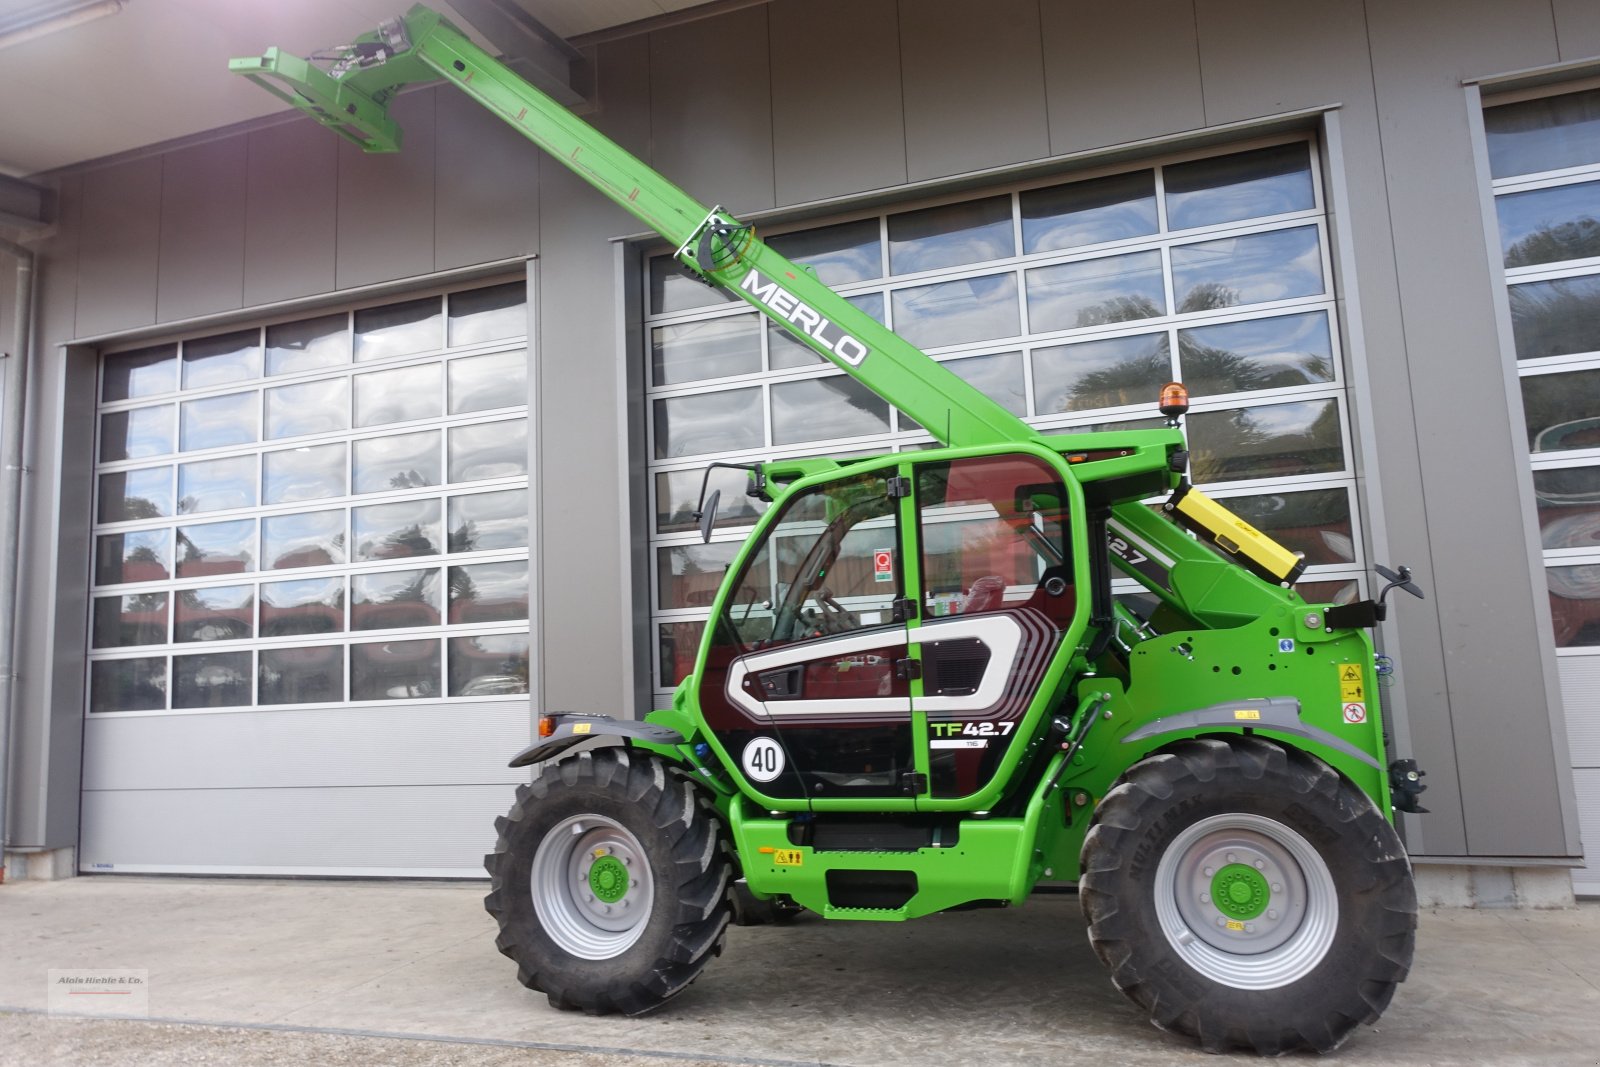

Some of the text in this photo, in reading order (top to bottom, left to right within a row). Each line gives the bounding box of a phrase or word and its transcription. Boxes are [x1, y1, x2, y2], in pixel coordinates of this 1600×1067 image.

[741, 269, 867, 366] MERLO
[1106, 530, 1148, 565] 2.7
[751, 746, 776, 772] 40
